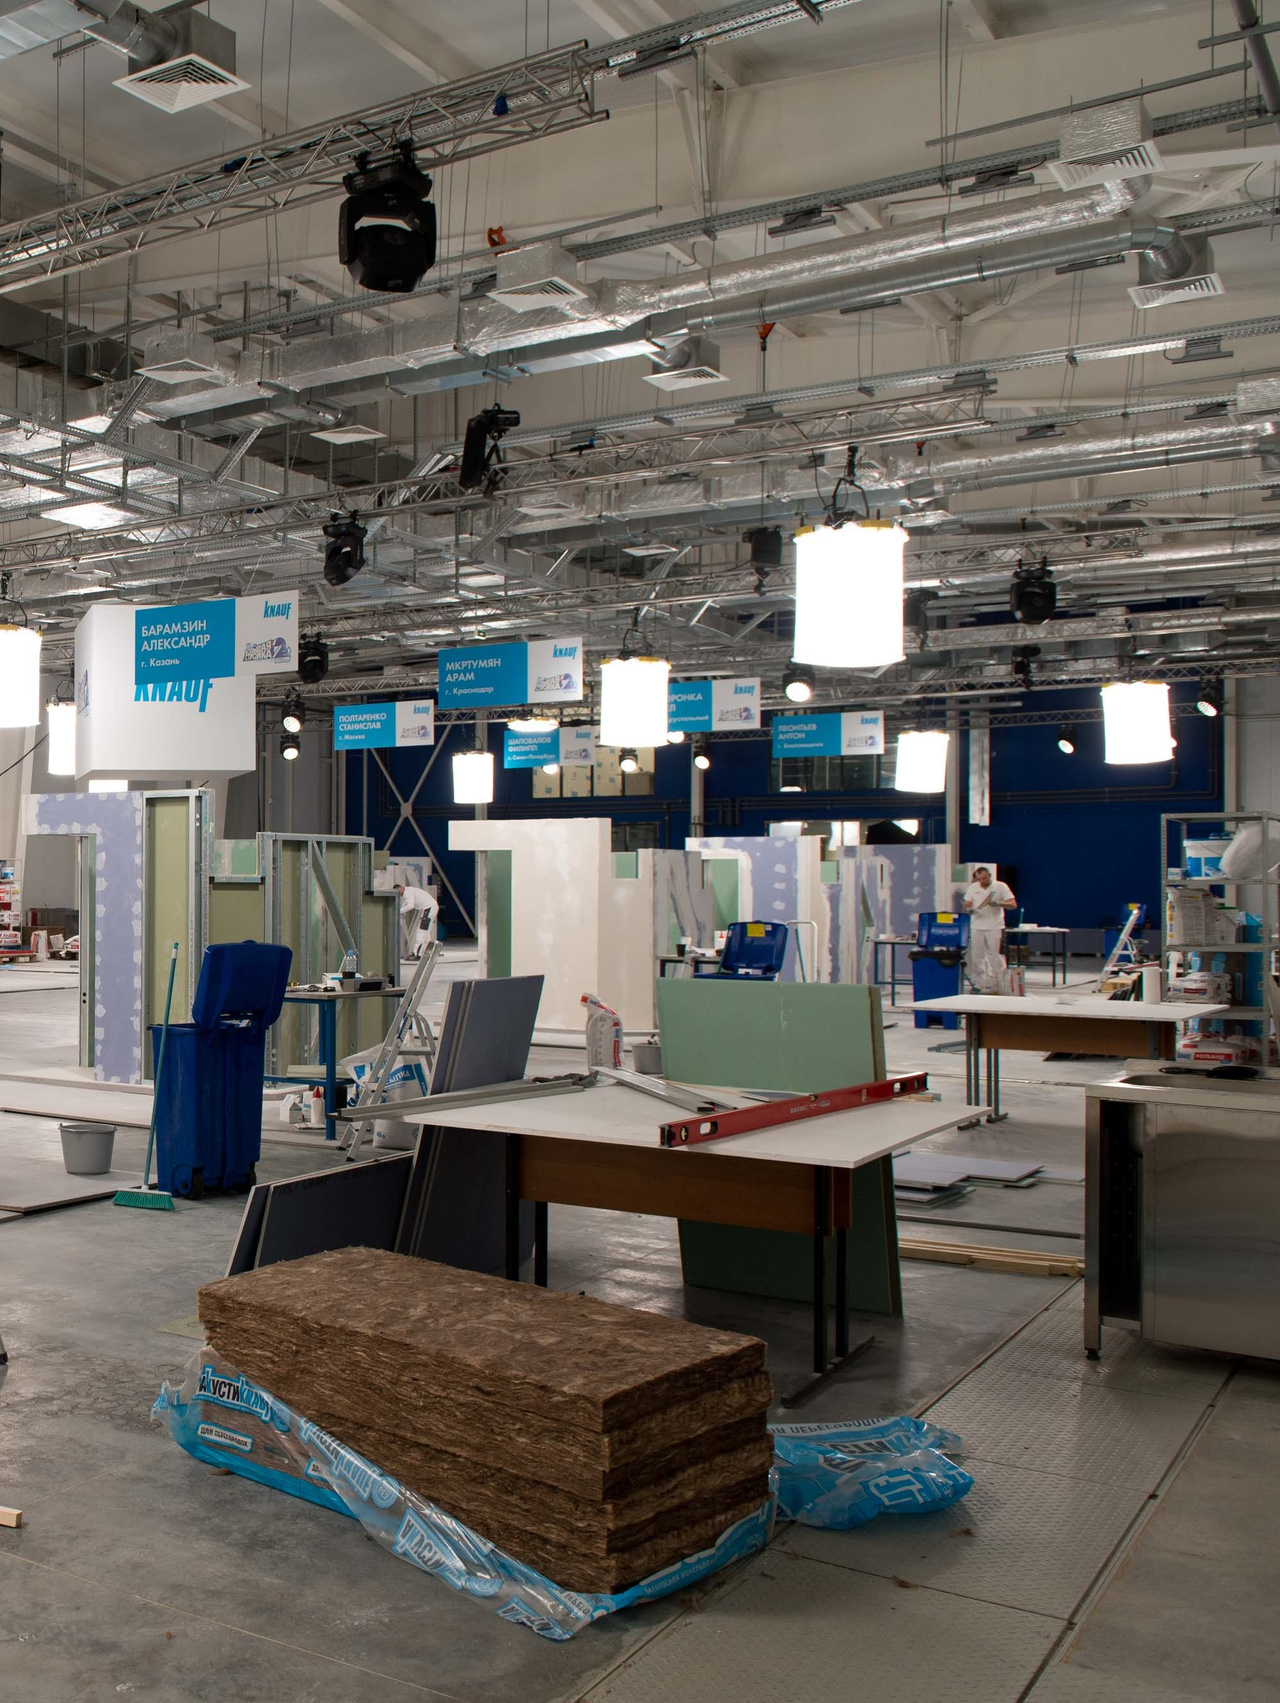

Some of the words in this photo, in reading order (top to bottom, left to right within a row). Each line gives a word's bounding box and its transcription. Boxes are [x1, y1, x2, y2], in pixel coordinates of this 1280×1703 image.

[263, 601, 291, 619] KNAUF
[141, 620, 207, 637] БАРАМЗИН
[141, 634, 211, 652] АЛЕКСАНДР
[553, 644, 577, 660] KNAUF
[149, 657, 180, 667] Казань
[446, 658, 501, 671] МКРТУМЯН
[445, 672, 475, 683] АРАМ
[453, 686, 494, 697] Краснодар
[668, 693, 703, 702] РОНКА
[339, 713, 387, 723] ПОЛТАРЕНКО
[339, 722, 381, 731] СТАНИСЛАВ
[778, 732, 805, 740] АНТОН
